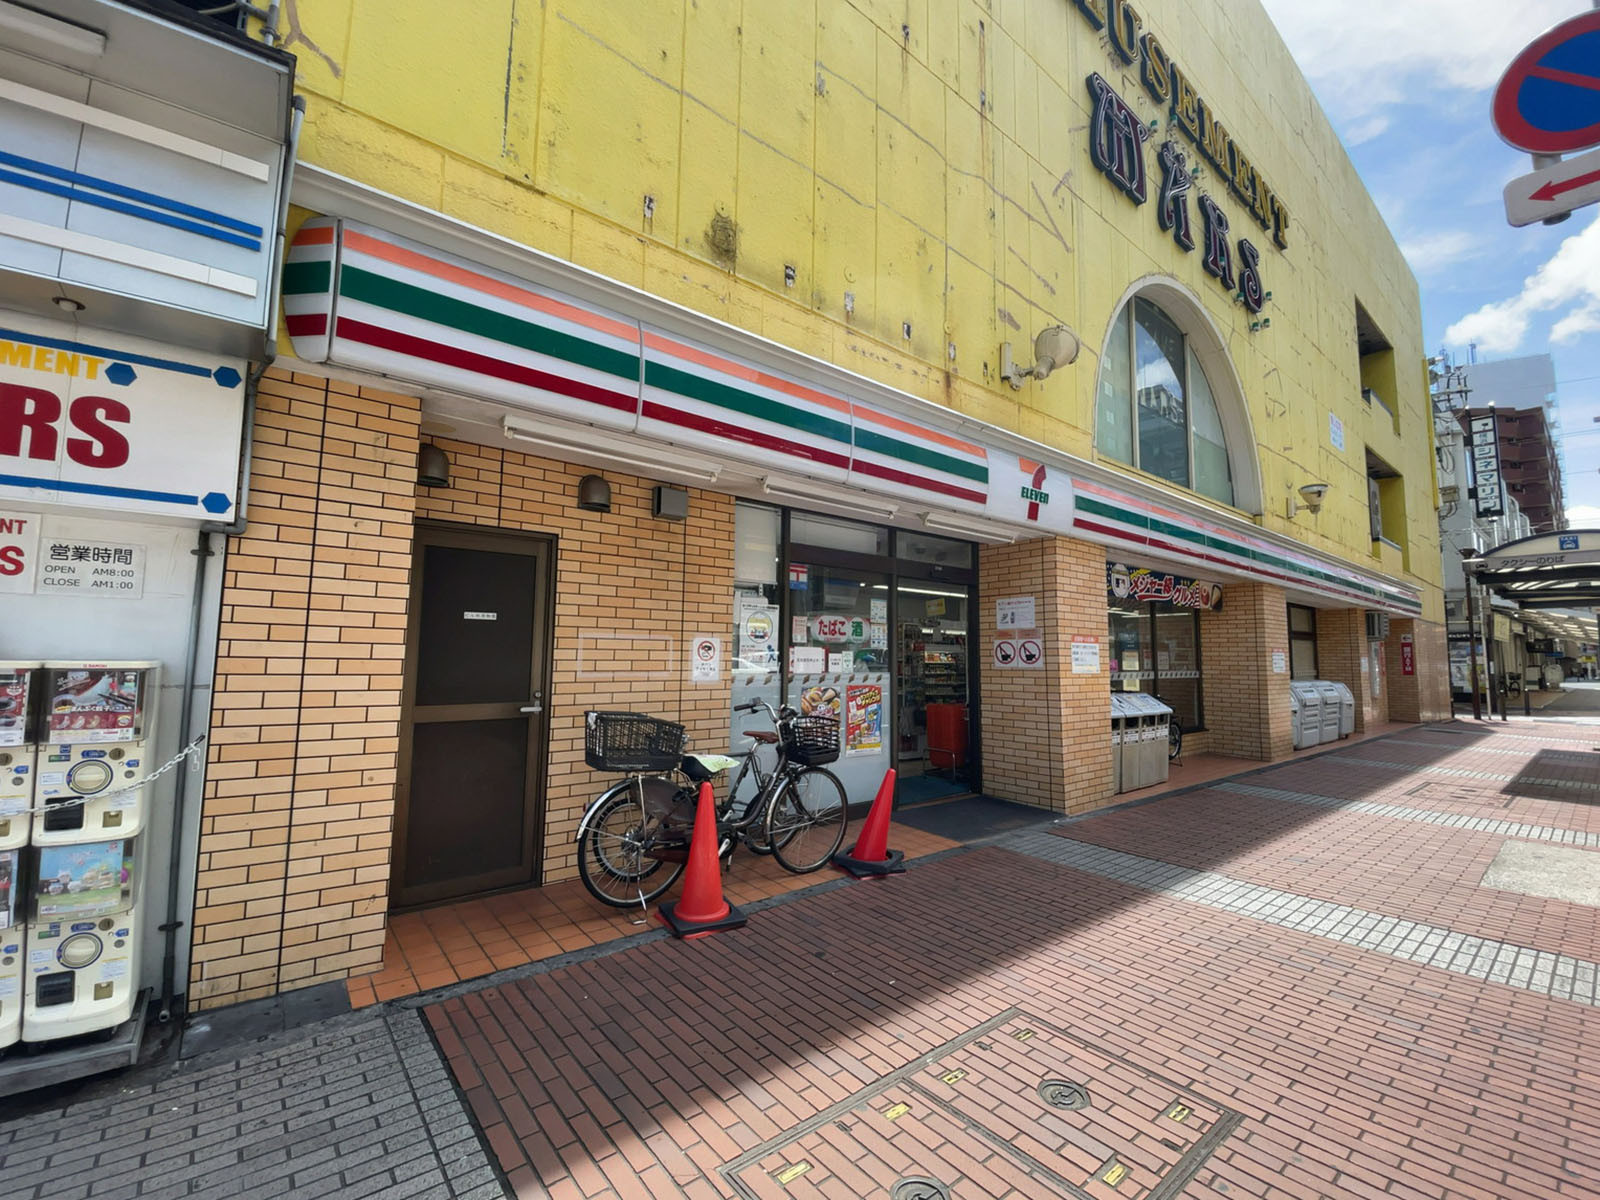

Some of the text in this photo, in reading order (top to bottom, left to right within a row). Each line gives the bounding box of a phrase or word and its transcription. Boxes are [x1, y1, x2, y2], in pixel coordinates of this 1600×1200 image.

[1085, 71, 1262, 314] MARS
[0, 341, 104, 380] MENT
[0, 382, 131, 469] RS
[0, 518, 27, 535] NT
[0, 545, 25, 576] S
[50, 543, 133, 566] 営業時間
[44, 564, 134, 578] OPEN AM8:00
[43, 577, 133, 590] CLOSE AM1:00
[818, 619, 847, 636] たばこ
[851, 621, 863, 637] 酒
